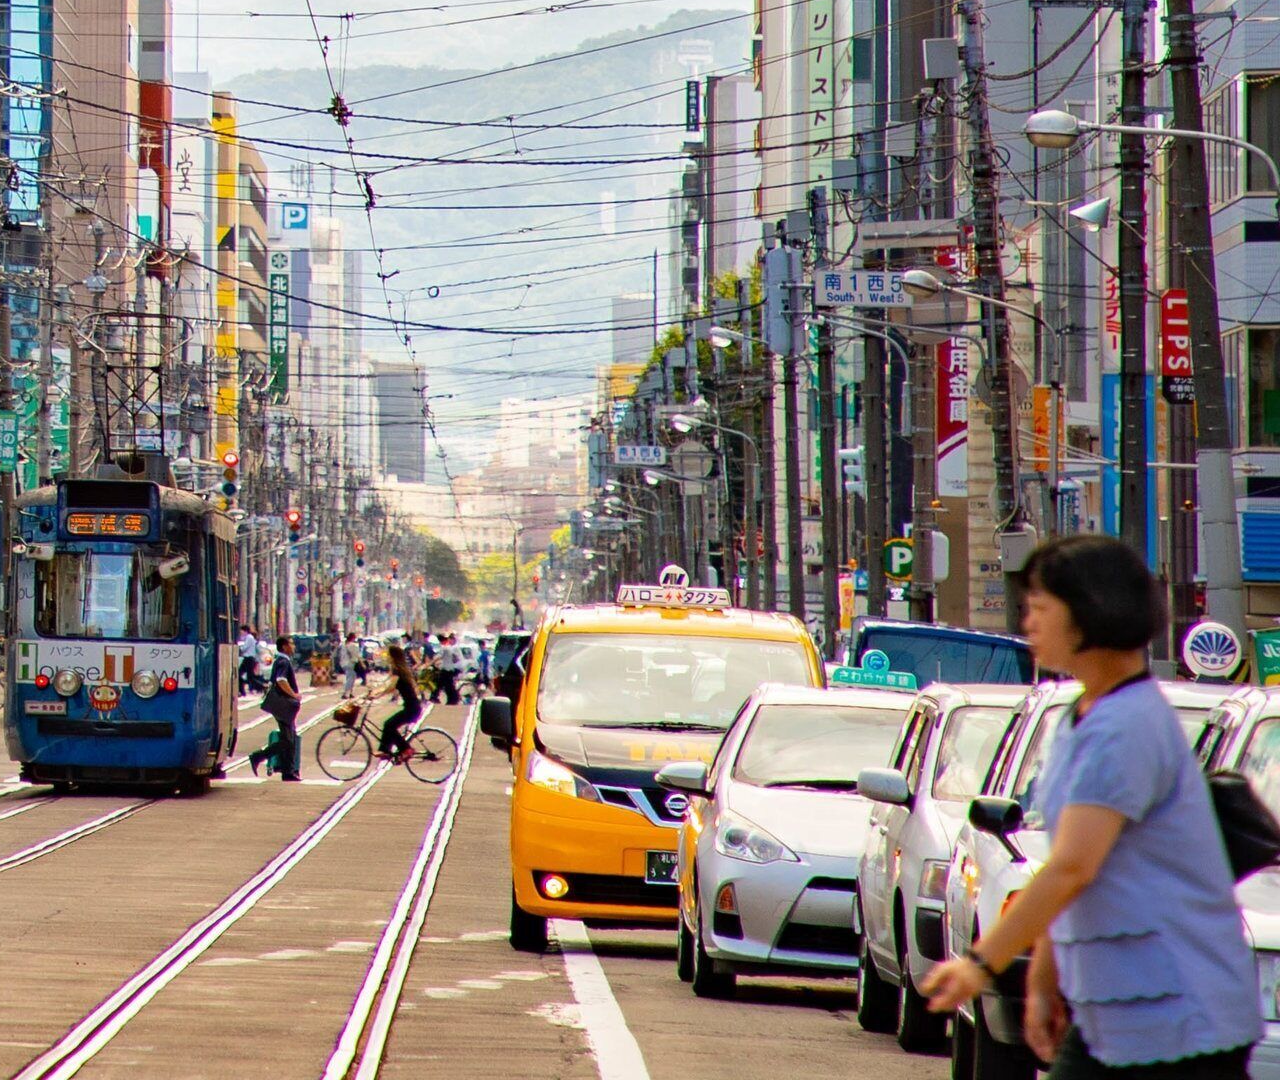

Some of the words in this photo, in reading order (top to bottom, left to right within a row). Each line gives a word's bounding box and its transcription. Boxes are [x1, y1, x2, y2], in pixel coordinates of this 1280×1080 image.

[284, 204, 307, 227] P
[826, 293, 855, 303] South
[869, 293, 896, 303] West
[1167, 297, 1188, 370] LIPS
[891, 546, 913, 574] P
[622, 589, 663, 601] ハロー
[683, 591, 727, 604] タクシー
[50, 646, 84, 658] ハウス
[149, 647, 183, 659] タウン
